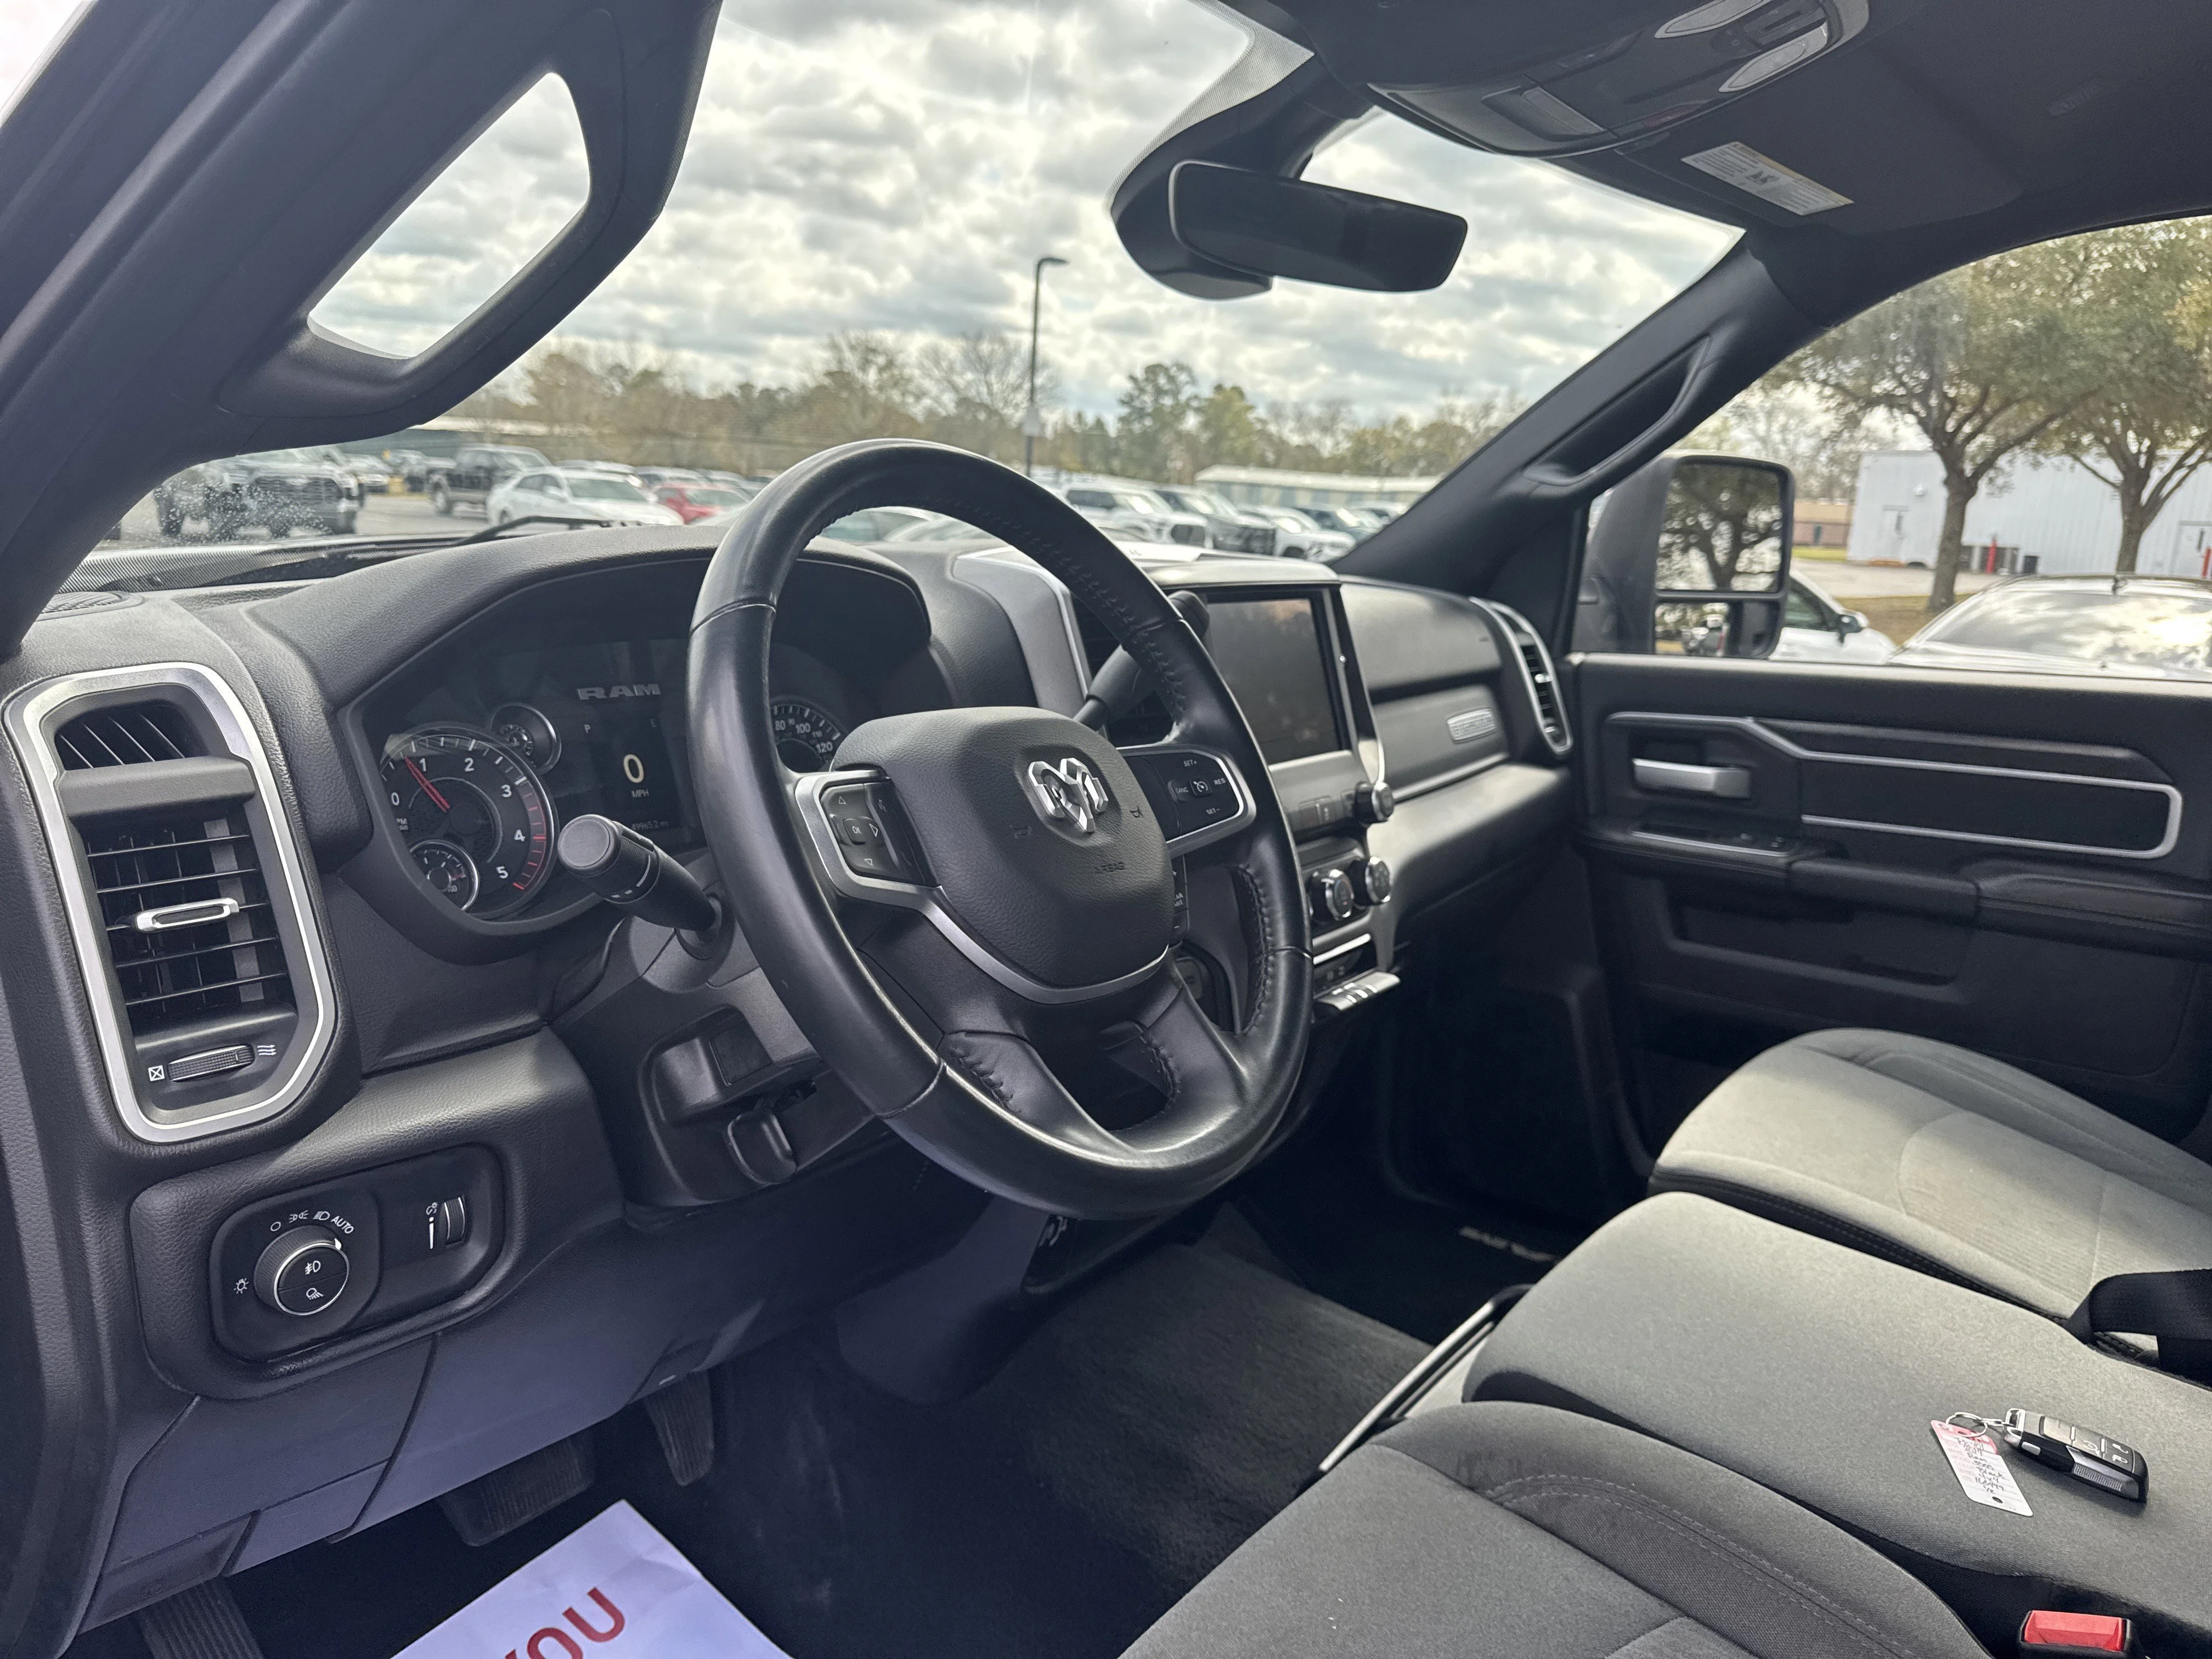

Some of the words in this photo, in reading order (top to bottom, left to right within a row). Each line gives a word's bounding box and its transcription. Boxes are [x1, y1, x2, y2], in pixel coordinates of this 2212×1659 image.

[577, 684, 661, 700] RAM
[584, 724, 591, 733] P
[775, 720, 786, 731] 80
[795, 722, 811, 735] 100
[816, 741, 833, 753] 120
[419, 758, 426, 772] 1
[465, 758, 474, 772] 2
[623, 754, 644, 783] 0
[1214, 777, 1226, 786] RES
[501, 785, 512, 798] 3
[631, 789, 650, 798] MPH
[391, 792, 399, 806] 0
[514, 829, 526, 842] 4
[852, 826, 862, 834] OK
[496, 866, 509, 879] 5
[330, 1215, 355, 1234] AUTO
[505, 1587, 625, 1659] OU
